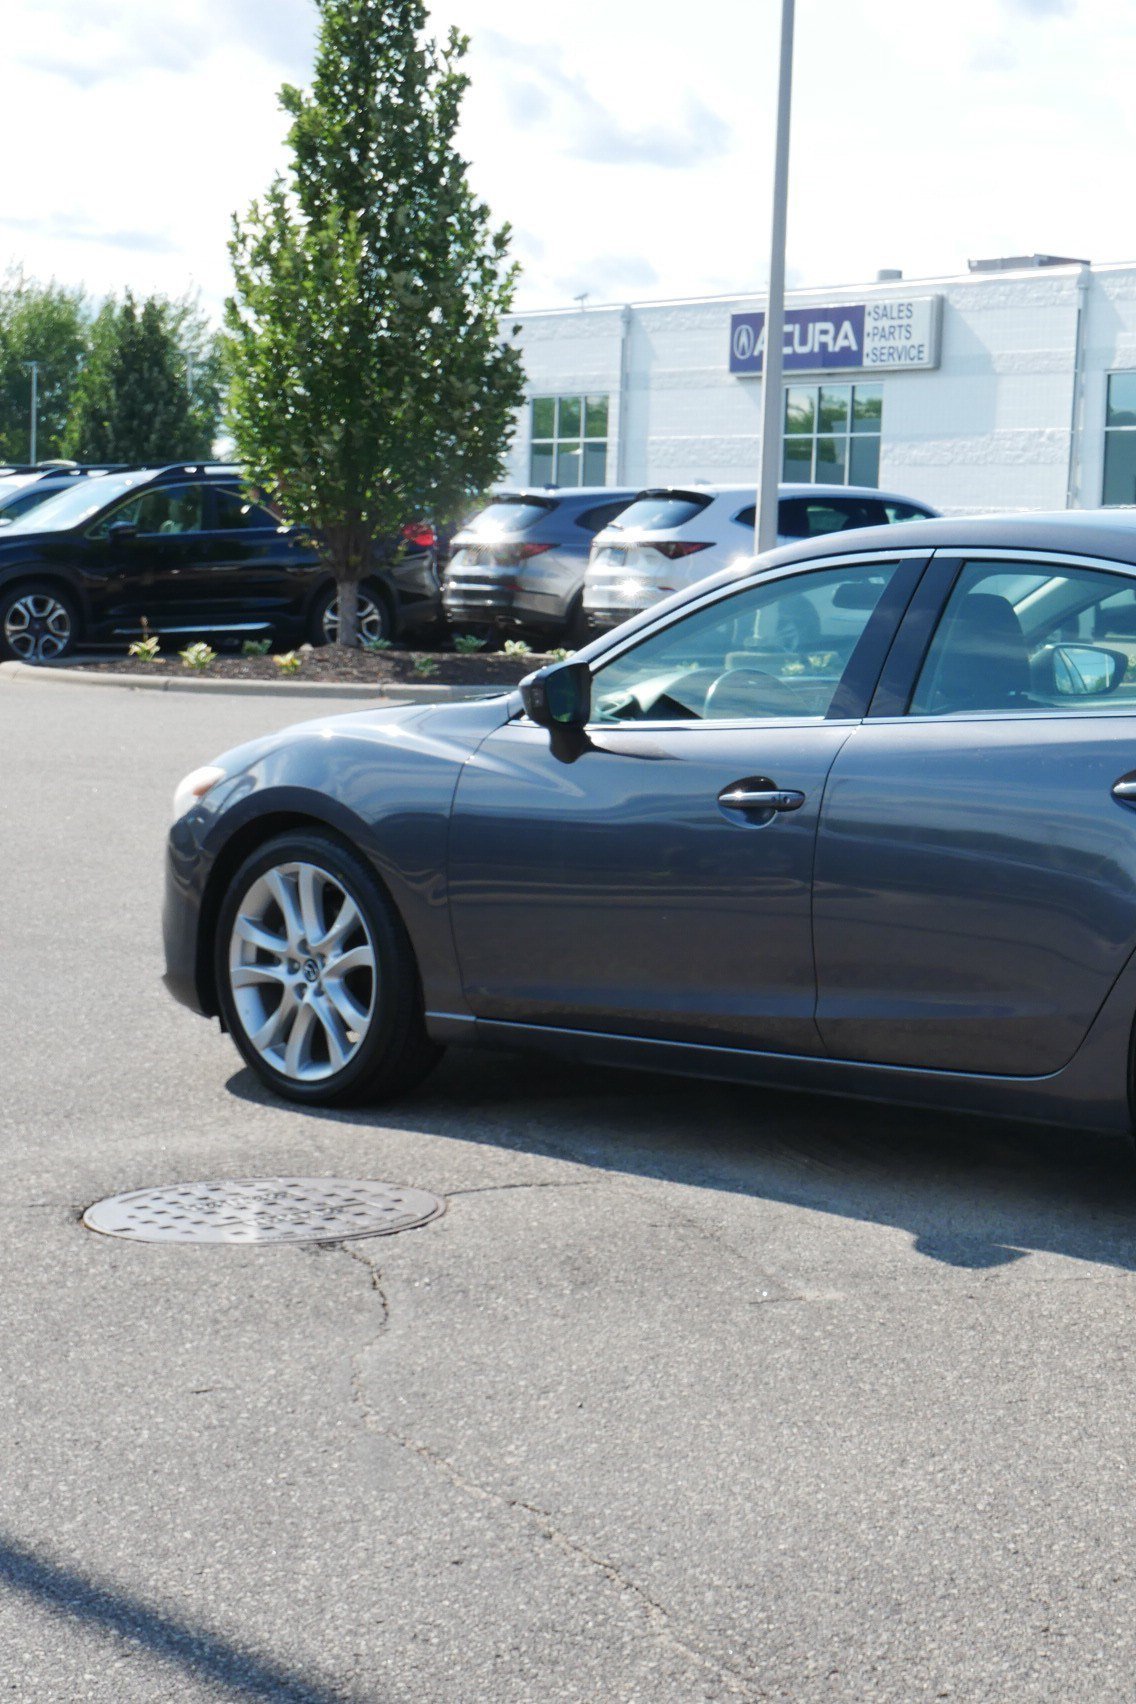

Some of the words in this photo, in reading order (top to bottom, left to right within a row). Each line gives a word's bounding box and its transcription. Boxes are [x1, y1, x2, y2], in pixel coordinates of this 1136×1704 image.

[872, 303, 913, 321] SALES
[872, 324, 912, 343] PARTS
[870, 344, 925, 363] SERVICE
